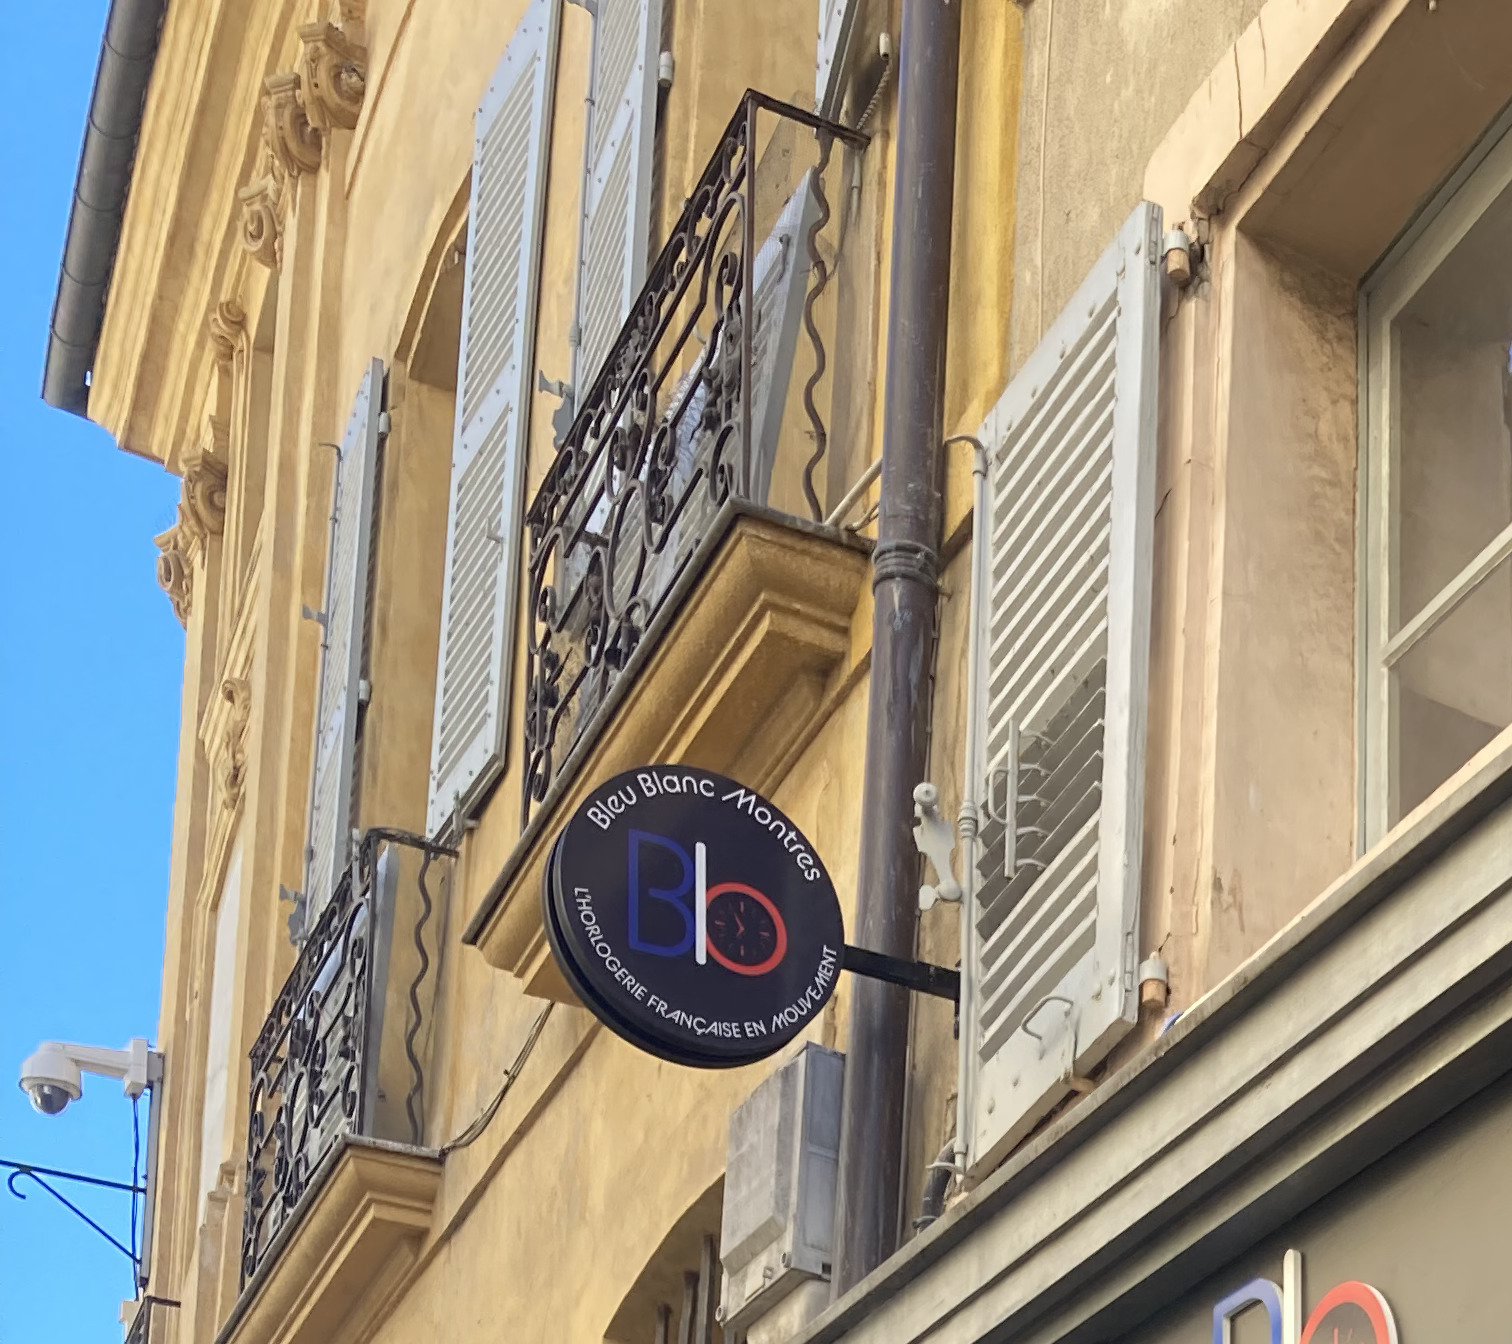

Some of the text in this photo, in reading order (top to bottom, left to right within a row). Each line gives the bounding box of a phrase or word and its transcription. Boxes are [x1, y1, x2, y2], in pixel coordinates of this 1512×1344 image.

[587, 771, 821, 882] Bleu Blanc Montres
[574, 887, 837, 1039] L'HORLOGERIE FRANÇAISE EN MOUVEMENT
